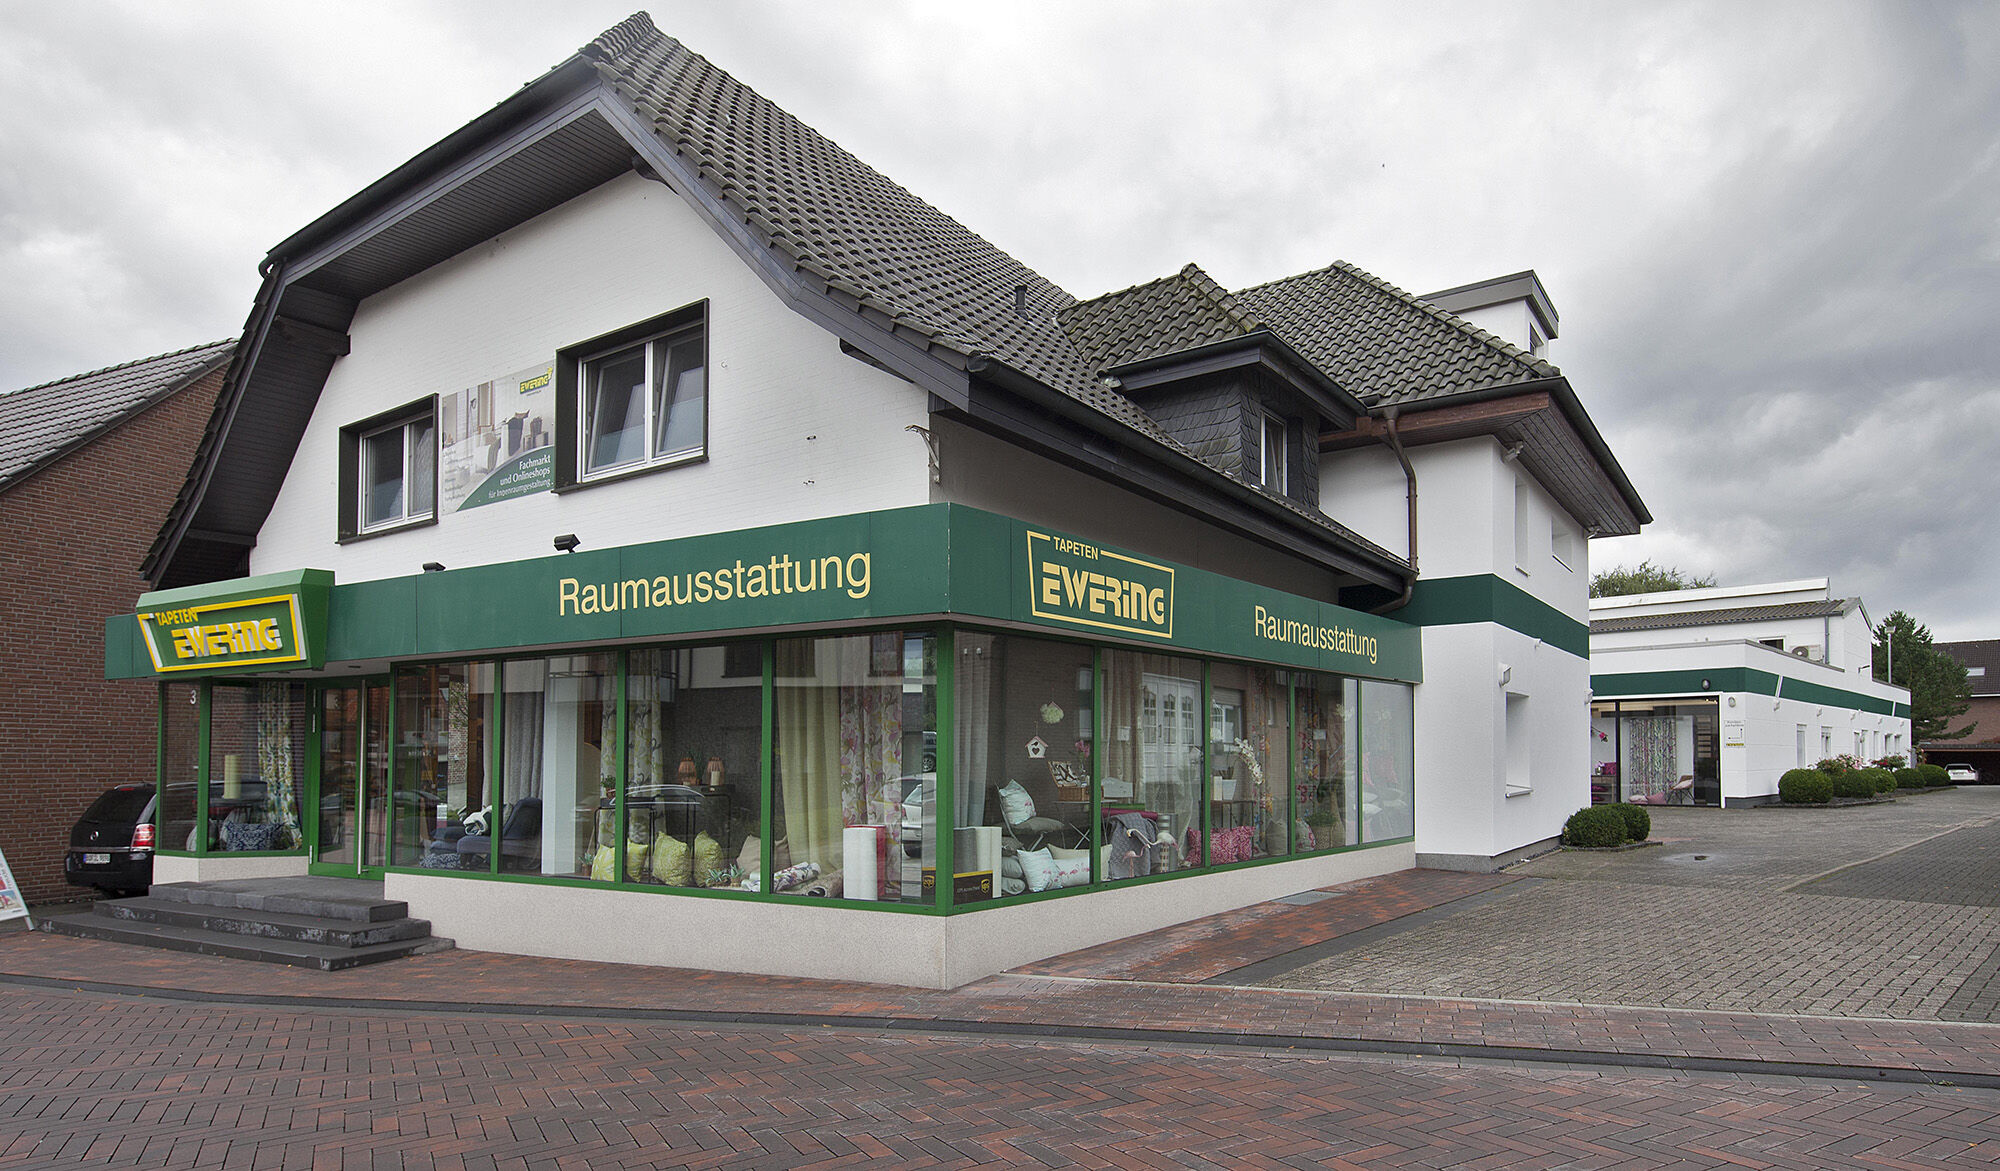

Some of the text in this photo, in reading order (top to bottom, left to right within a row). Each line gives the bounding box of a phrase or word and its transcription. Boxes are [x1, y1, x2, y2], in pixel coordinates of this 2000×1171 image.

[519, 454, 551, 470] Fachmarkt
[500, 466, 550, 485] und Onlineshops
[1053, 536, 1098, 560] TAPETEN
[559, 552, 871, 616] Raumausstattung
[155, 608, 199, 626] TAPETEN
[1254, 605, 1377, 665] Raumausstattung
[190, 689, 197, 705] 3
